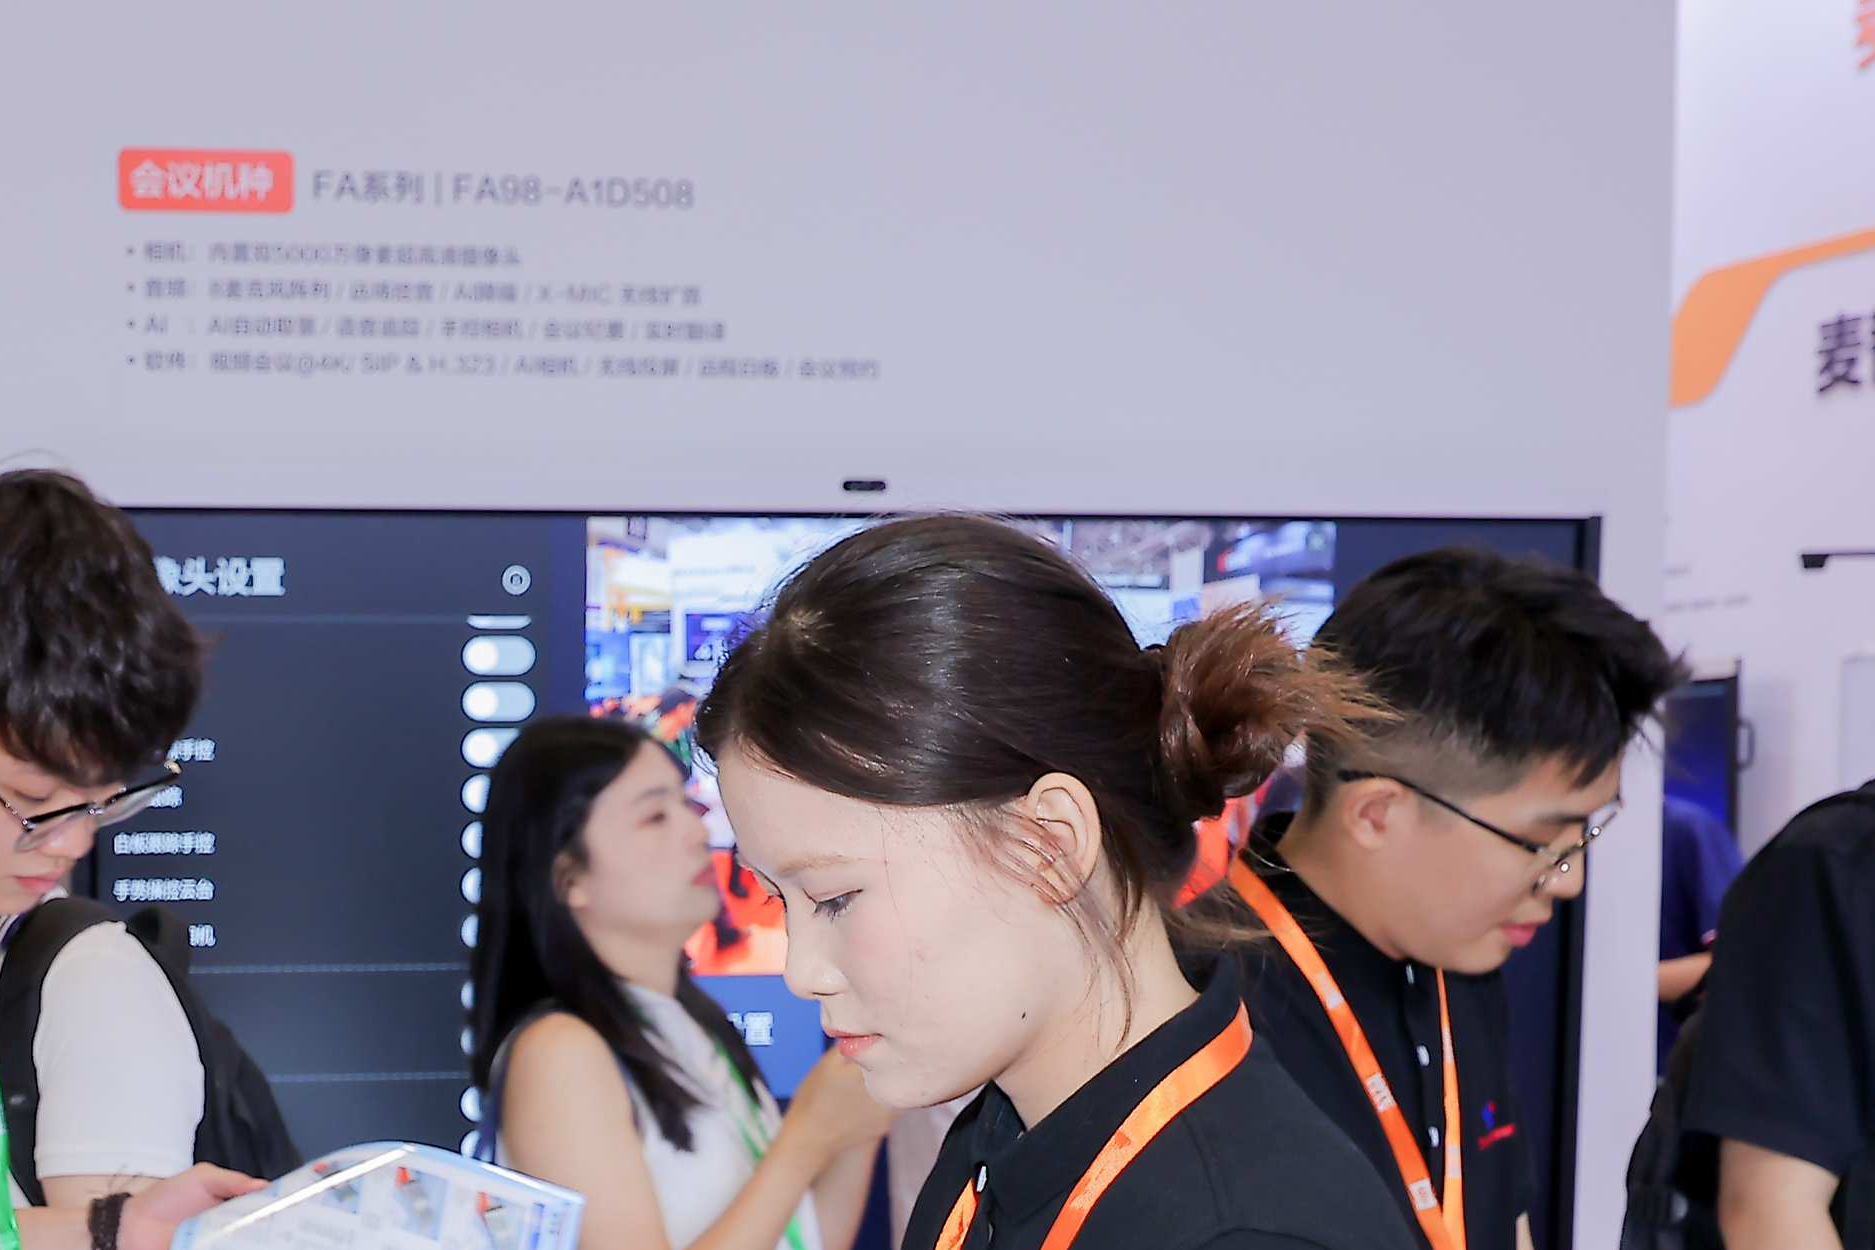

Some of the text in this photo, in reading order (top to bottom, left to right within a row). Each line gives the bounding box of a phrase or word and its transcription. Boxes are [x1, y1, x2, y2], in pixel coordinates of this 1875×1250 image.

[130, 160, 275, 201] 会议机种
[313, 170, 421, 204] FA系列
[452, 173, 694, 208] FA98-A1D508
